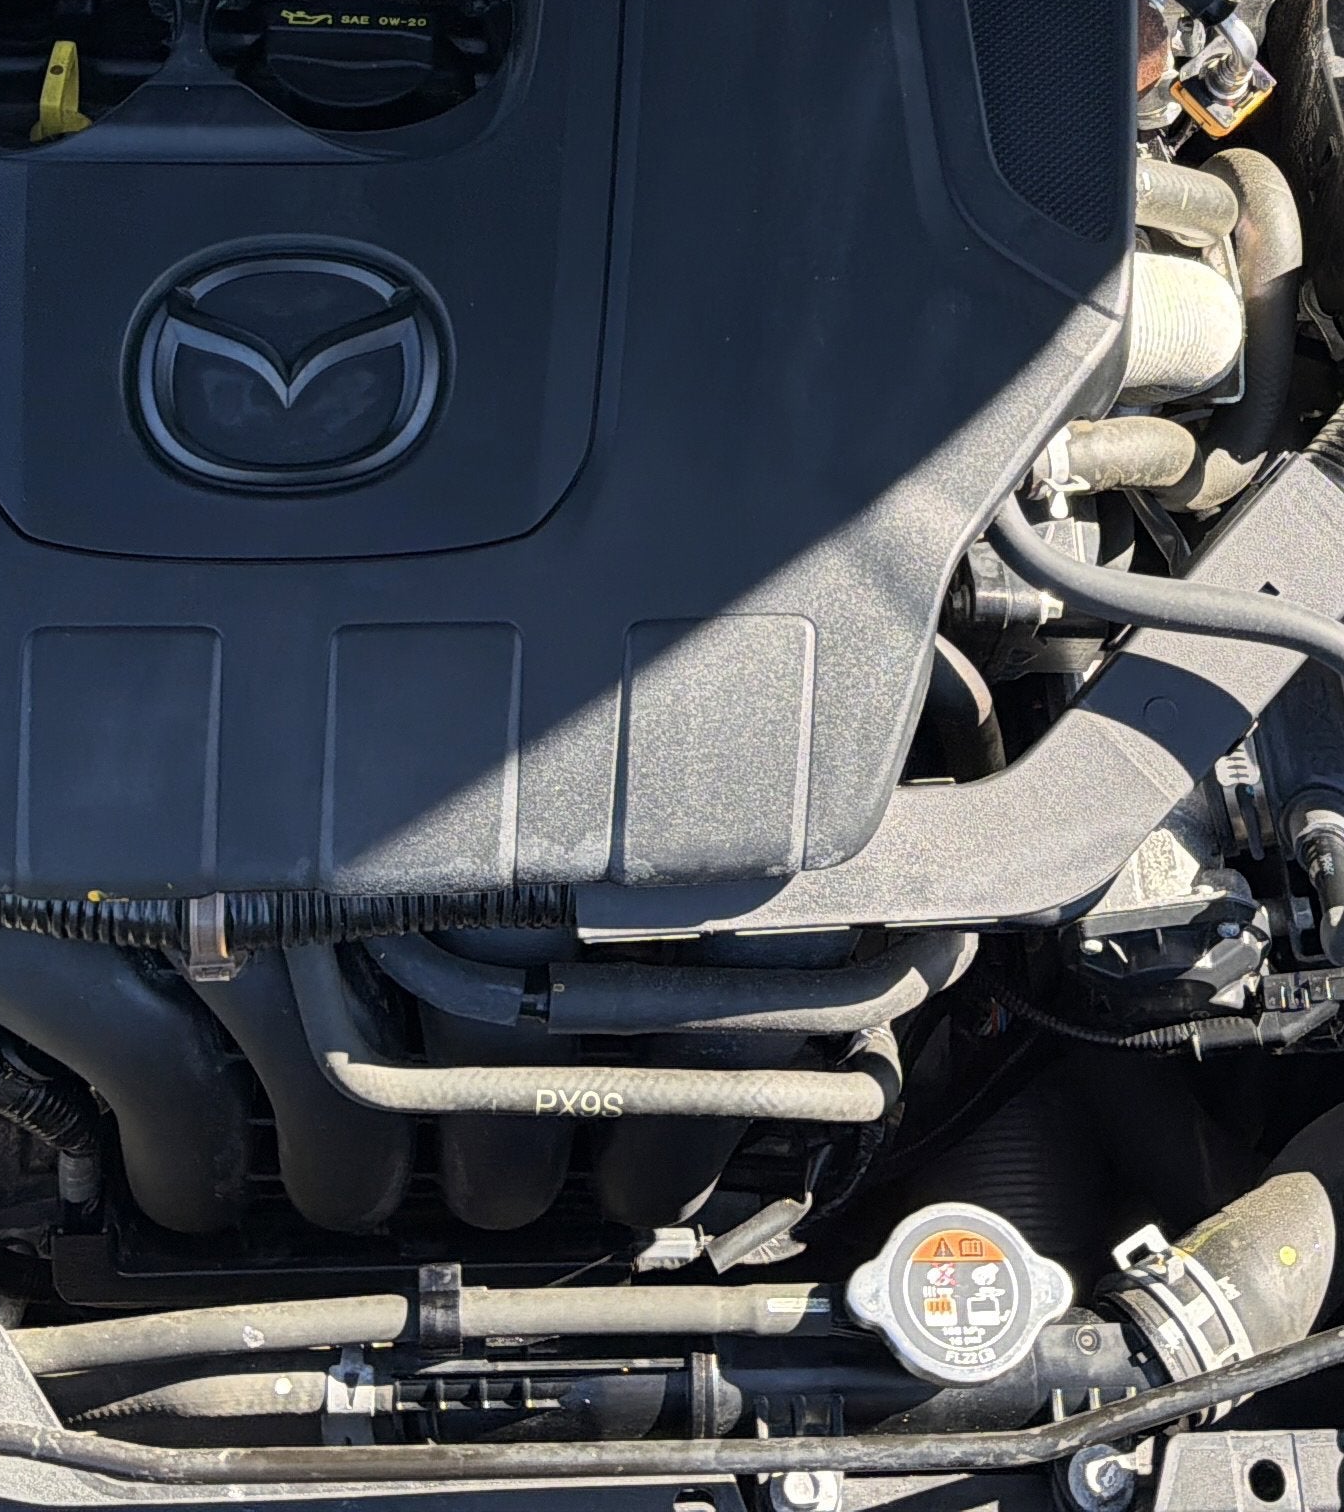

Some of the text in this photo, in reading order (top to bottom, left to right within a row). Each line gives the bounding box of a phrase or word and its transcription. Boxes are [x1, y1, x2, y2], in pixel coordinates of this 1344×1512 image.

[340, 15, 427, 27] SAE 0W-20
[536, 1089, 624, 1118] PX9S
